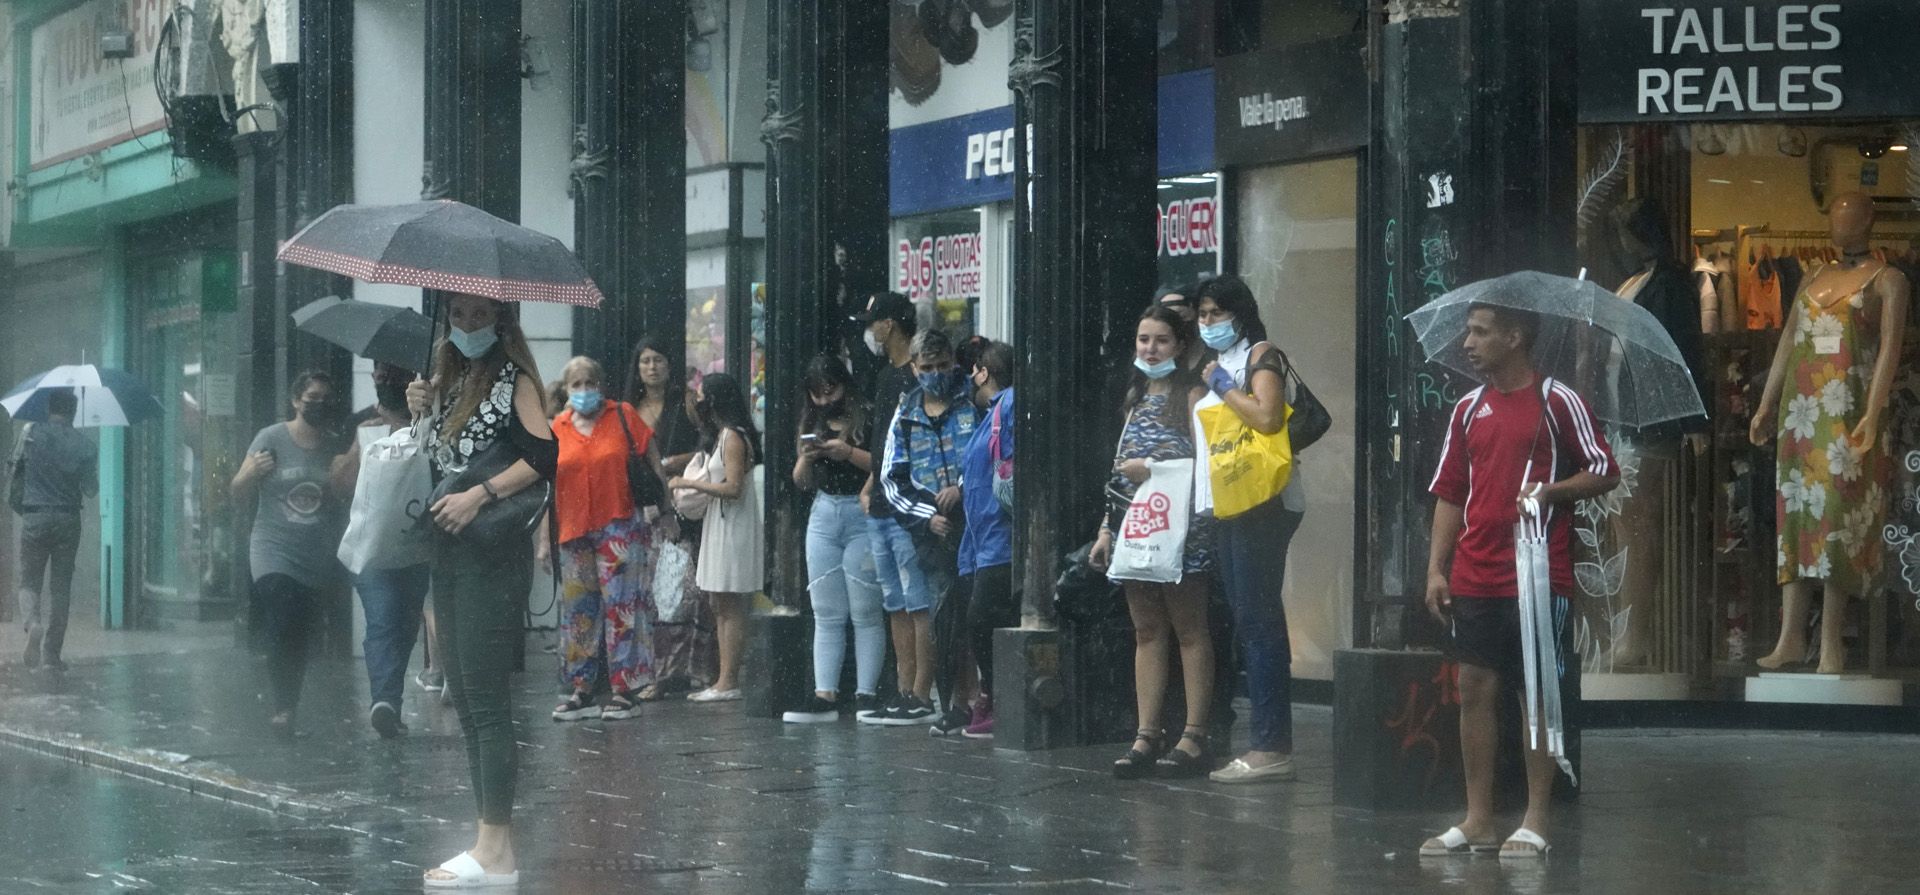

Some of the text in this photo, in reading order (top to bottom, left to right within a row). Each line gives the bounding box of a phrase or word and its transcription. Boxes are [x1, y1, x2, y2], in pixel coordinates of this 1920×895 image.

[1641, 4, 1841, 54] TALLES
[1239, 95, 1263, 128] Vale
[1263, 92, 1274, 124] la
[1638, 65, 1843, 114] REALES
